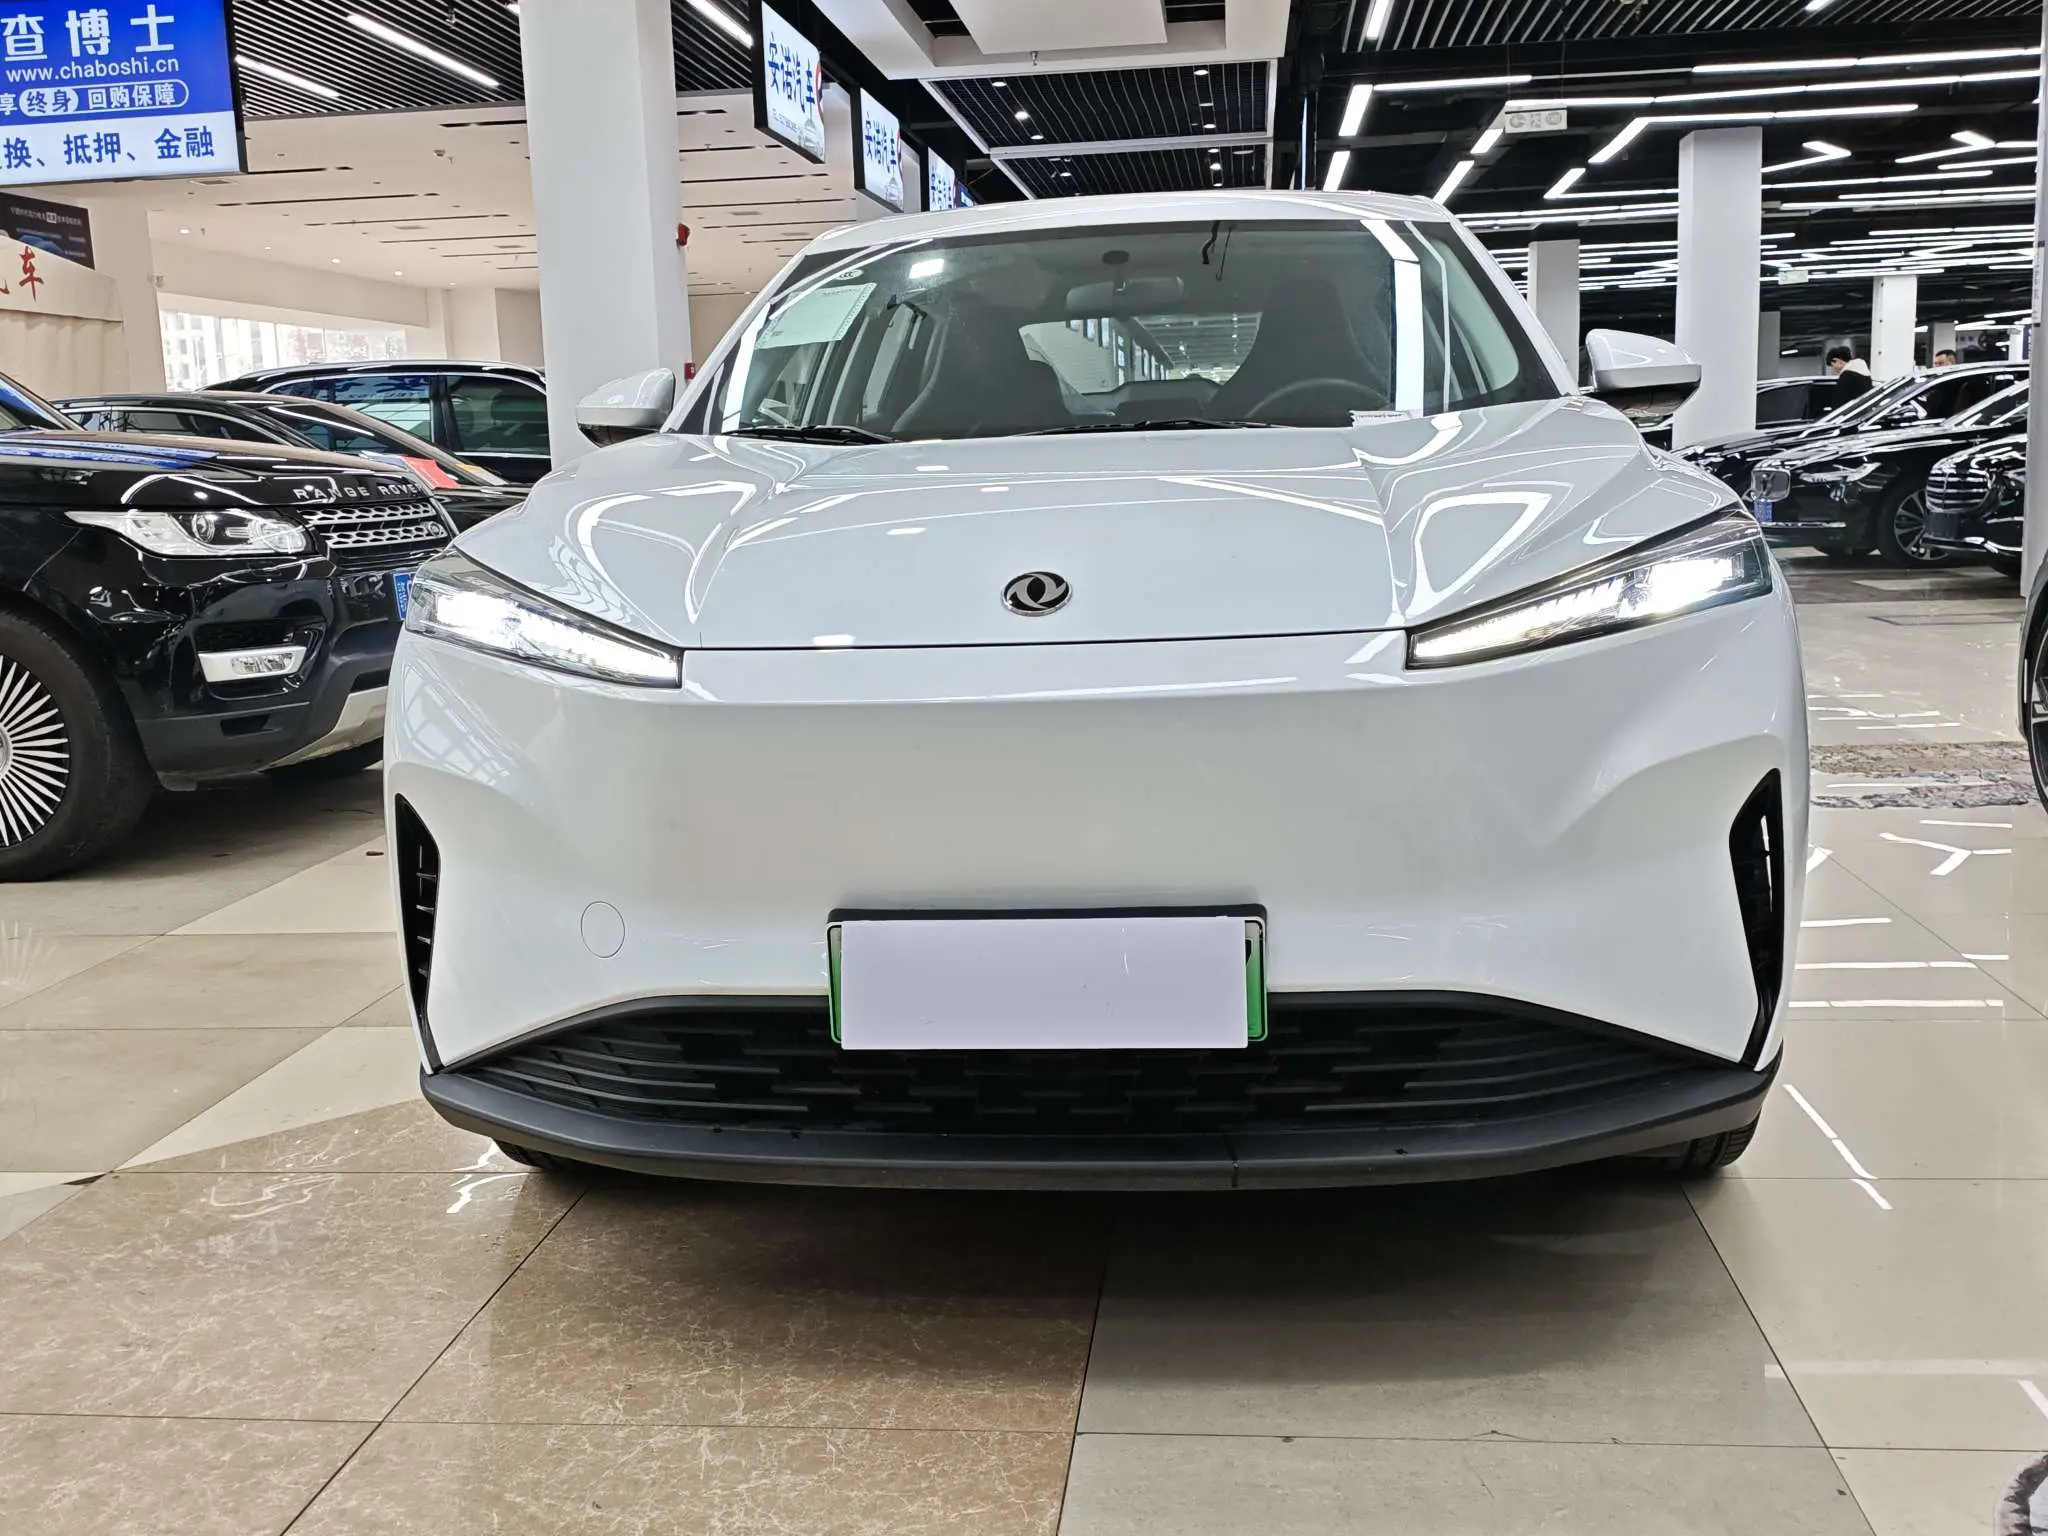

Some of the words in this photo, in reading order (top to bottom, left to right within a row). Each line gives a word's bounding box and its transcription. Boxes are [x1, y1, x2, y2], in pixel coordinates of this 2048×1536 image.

[1, 4, 175, 61] 查博士
[6, 57, 179, 82] www.chaboshi.cn
[768, 31, 815, 119] 安诺汽车
[0, 126, 215, 169] 换、抵押、金融
[865, 112, 897, 177] 安诺汽车
[293, 486, 370, 499] RANGE
